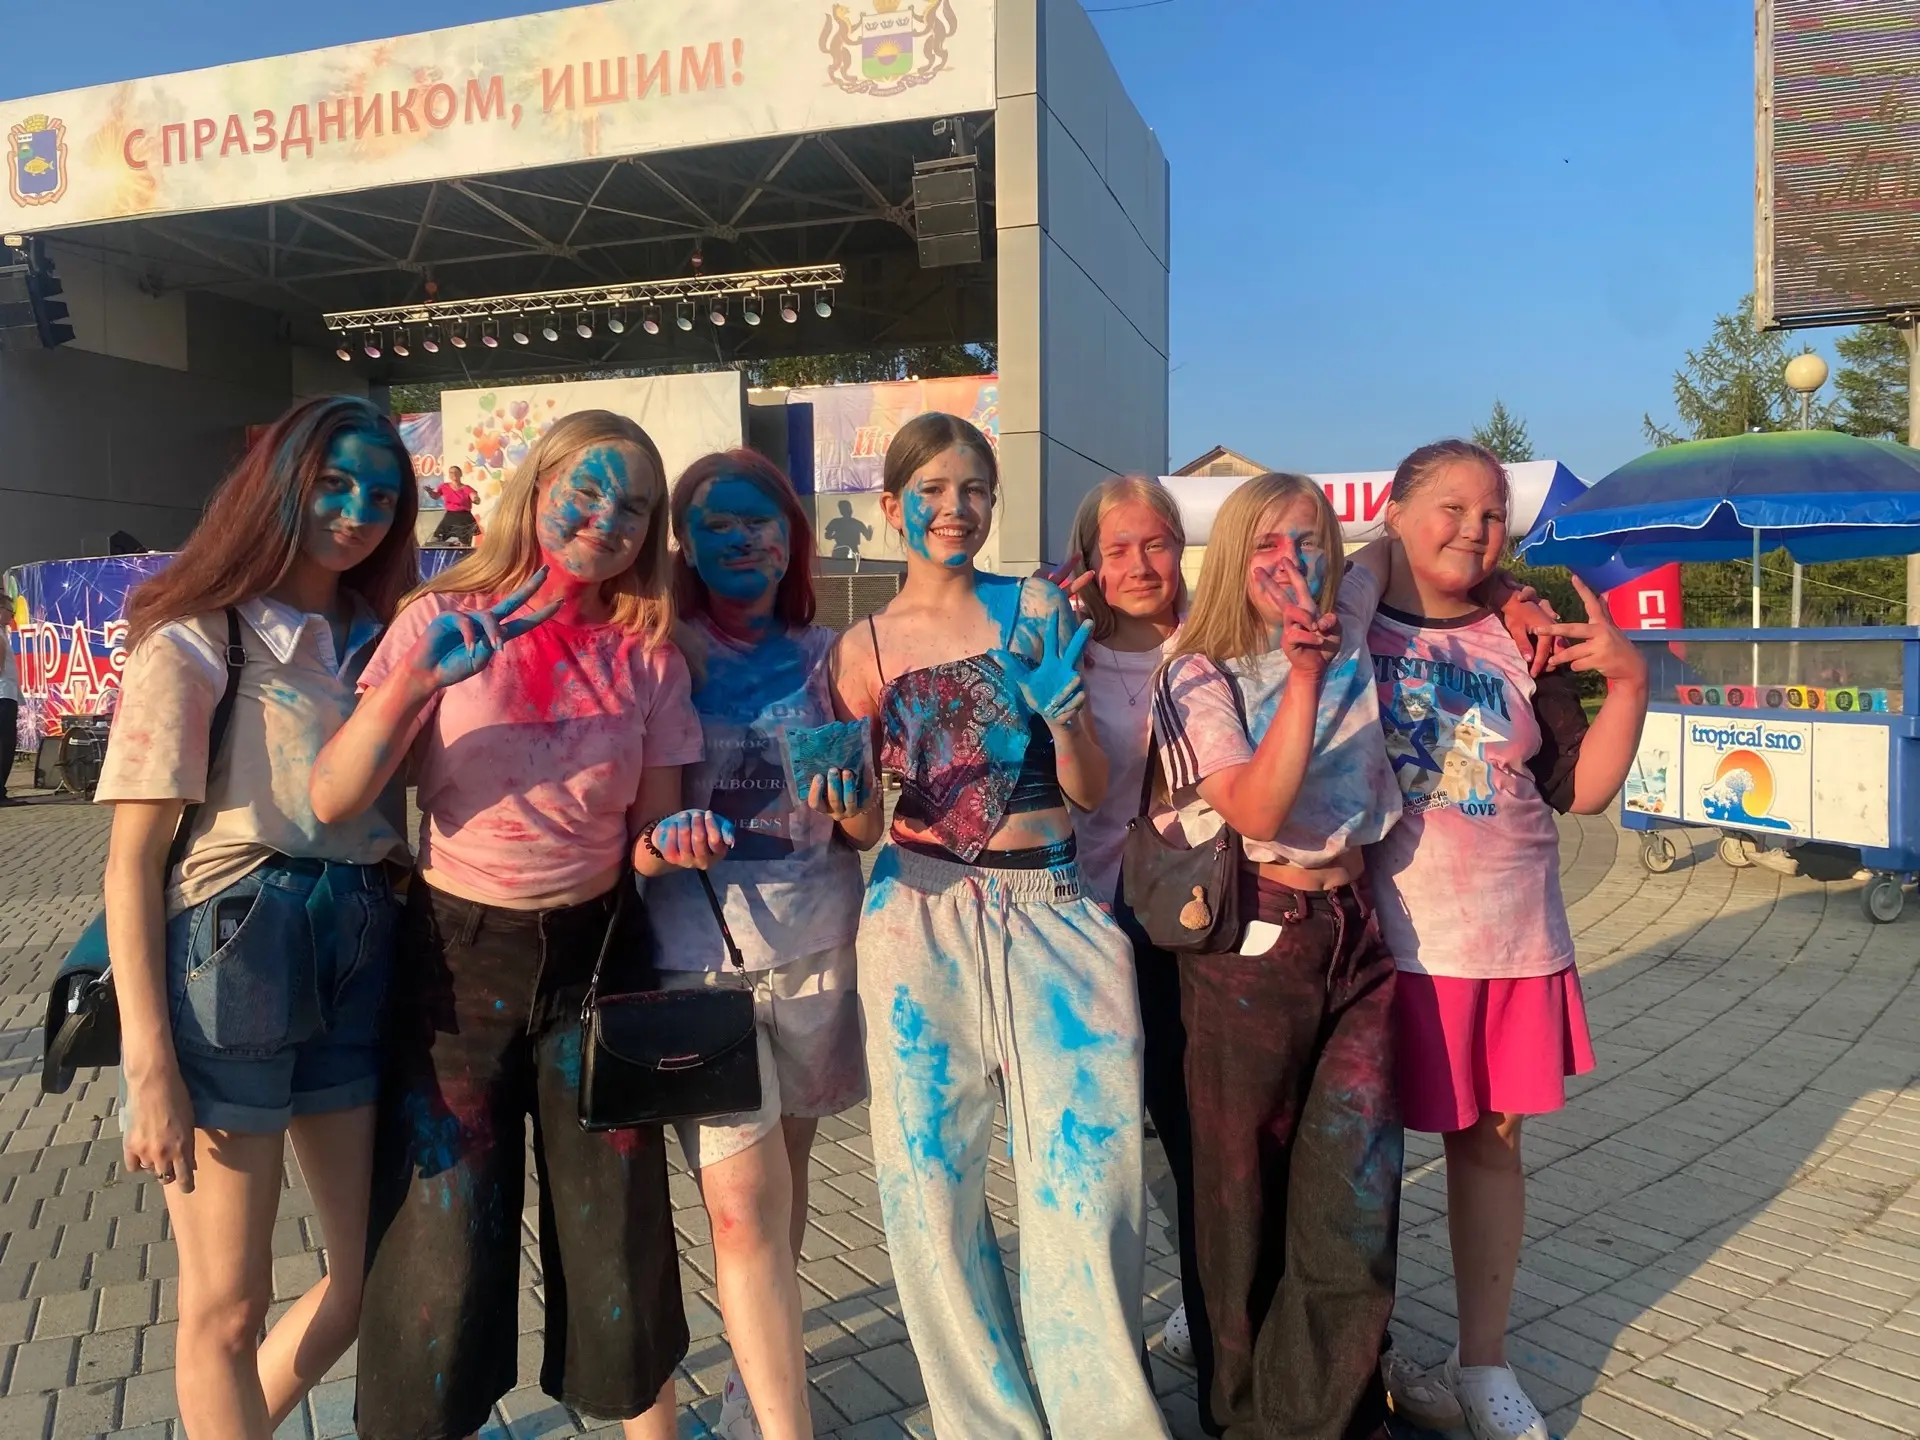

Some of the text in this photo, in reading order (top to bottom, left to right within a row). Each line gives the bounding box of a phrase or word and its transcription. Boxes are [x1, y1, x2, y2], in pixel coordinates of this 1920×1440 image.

[123, 37, 745, 169] С ПРАЗДНИКОМ, ИШИМ!
[1692, 724, 1801, 750] tropical sno
[1460, 803, 1497, 816] LOVE
